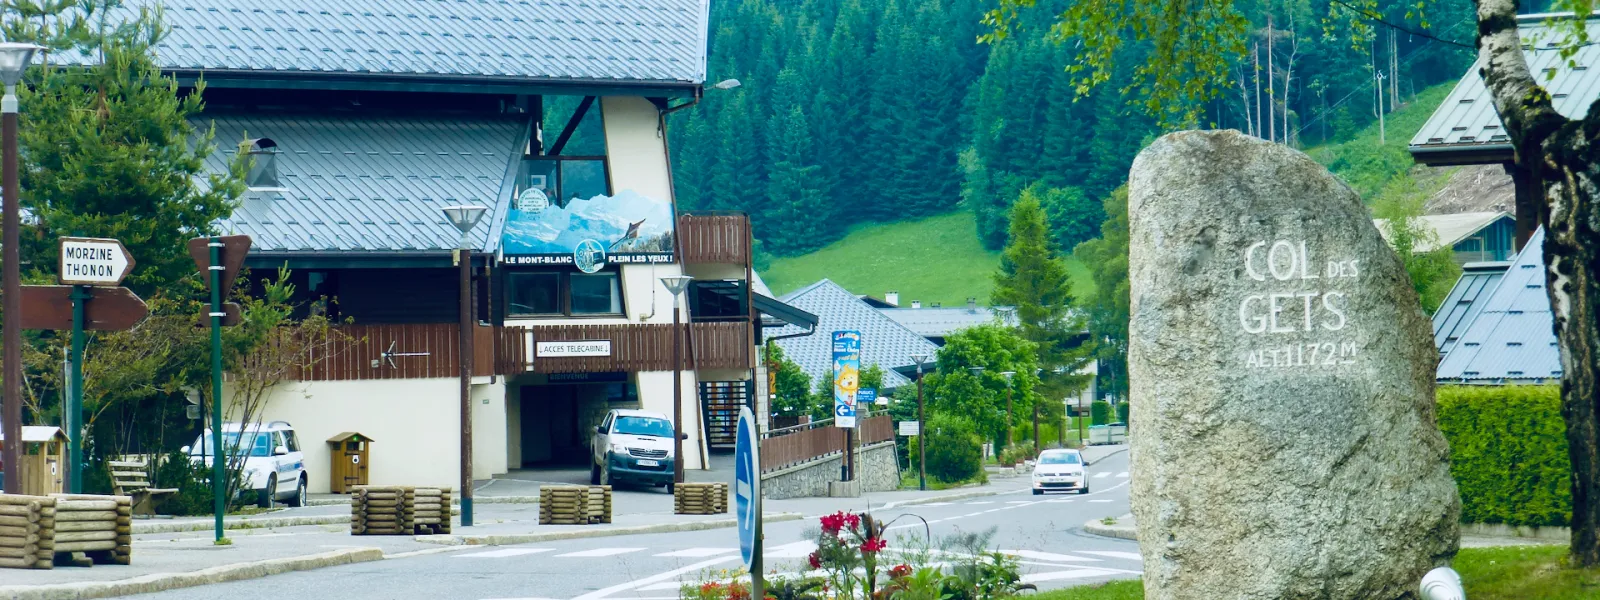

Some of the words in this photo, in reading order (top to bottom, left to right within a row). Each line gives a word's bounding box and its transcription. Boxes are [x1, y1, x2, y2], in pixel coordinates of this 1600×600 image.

[66, 247, 112, 260] MORZINE
[505, 256, 516, 264] LE
[518, 256, 572, 264] MONT-BLANC
[608, 255, 631, 263] PLEIN
[633, 255, 646, 263] LES
[1244, 240, 1320, 281] COL
[1328, 260, 1359, 278] DES
[66, 264, 112, 276] THONON
[1239, 291, 1345, 334] GETS
[549, 372, 589, 380] BIENVENUE
